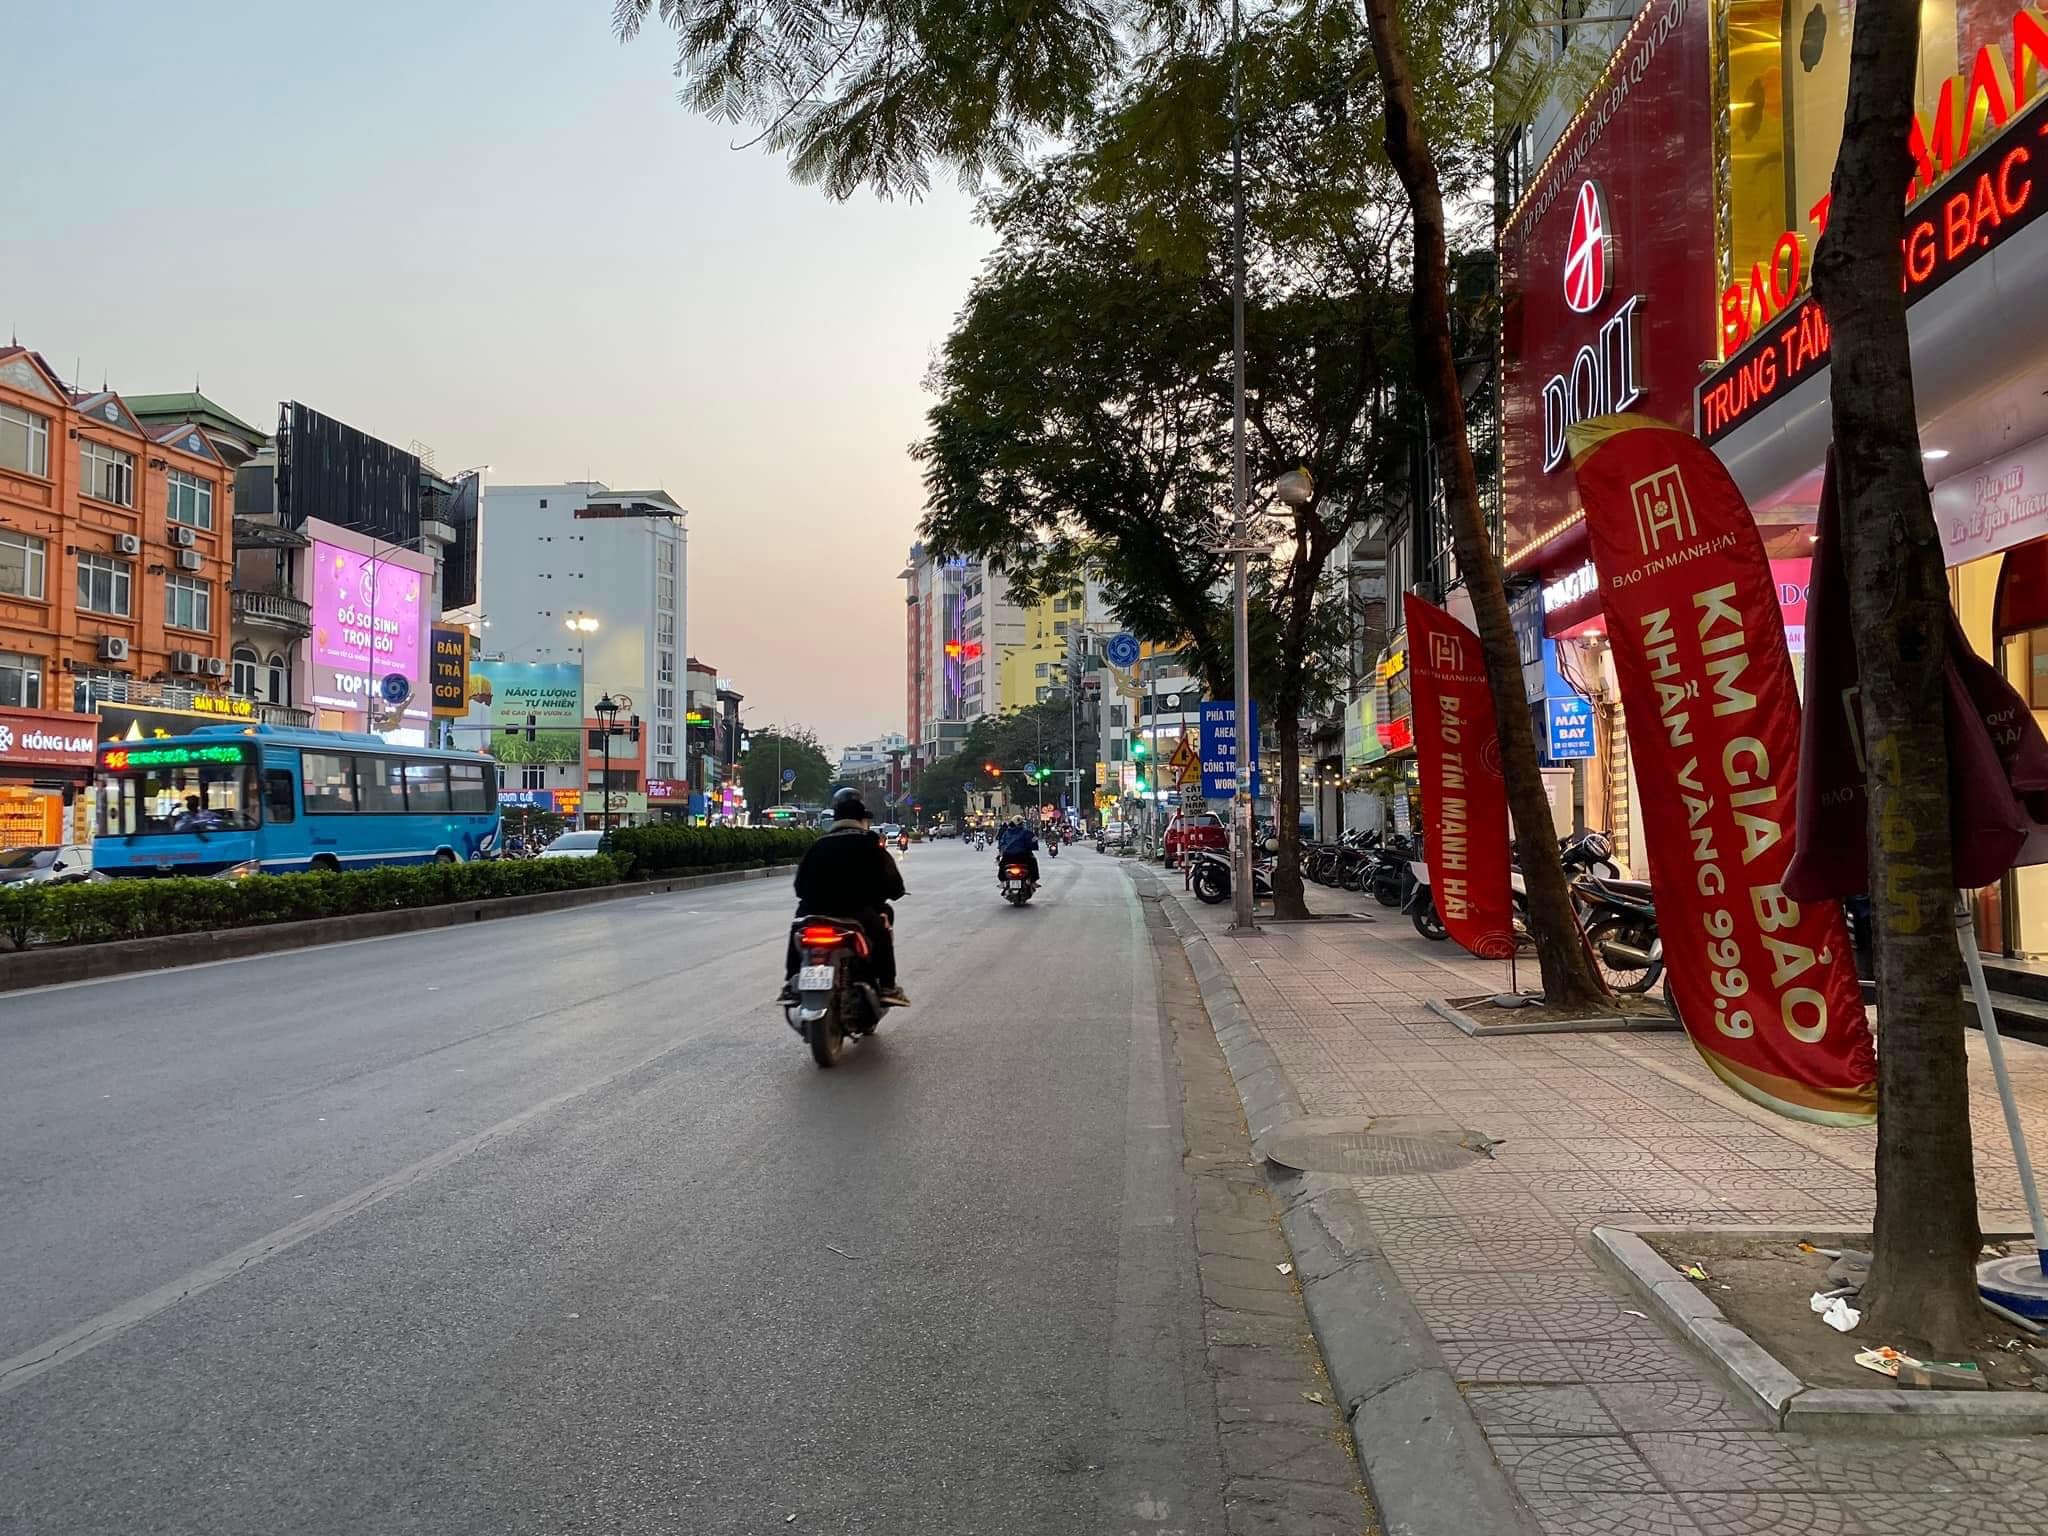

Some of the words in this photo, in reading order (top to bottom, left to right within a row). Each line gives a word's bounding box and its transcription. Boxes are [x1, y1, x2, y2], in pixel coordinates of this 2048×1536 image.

[1535, 176, 1561, 224] ĐOÀN
[1562, 132, 1588, 183] VÀNG
[1589, 104, 1611, 146] BẠC
[1612, 66, 1629, 113] ĐÁ
[1630, 23, 1658, 84] QUÝ
[1945, 146, 2030, 261] BẠC
[1703, 346, 1777, 436] TRUNG
[373, 617, 399, 634] SINH
[374, 635, 393, 652] GÓI
[437, 640, 462, 656] BÁN
[1692, 581, 1757, 718] KIM
[438, 661, 461, 677] TRẢ
[335, 673, 362, 694] TOP
[435, 682, 461, 698] GÓP
[505, 687, 538, 697] NĂNG
[540, 687, 577, 698] LƯỢNG
[525, 699, 541, 708] TỰ
[541, 699, 575, 708] NHIÊN
[1206, 708, 1224, 721] PHÍA
[1439, 694, 1468, 745] BẢO
[1559, 728, 1586, 739] BAY
[64, 737, 93, 753] LAM
[1217, 745, 1228, 755] 50
[1203, 759, 1225, 773] CÔNG
[1441, 752, 1469, 790] TÍN
[1185, 801, 1207, 810] NAM
[1722, 736, 1783, 866] GIA
[1640, 607, 1701, 748] NHẪN
[1677, 755, 1726, 896] VÀNG
[1703, 909, 1755, 1039] 999.9
[1435, 799, 1468, 871] MẠNH
[1442, 878, 1478, 921] HẢI
[1749, 883, 1833, 1044] BẢO
